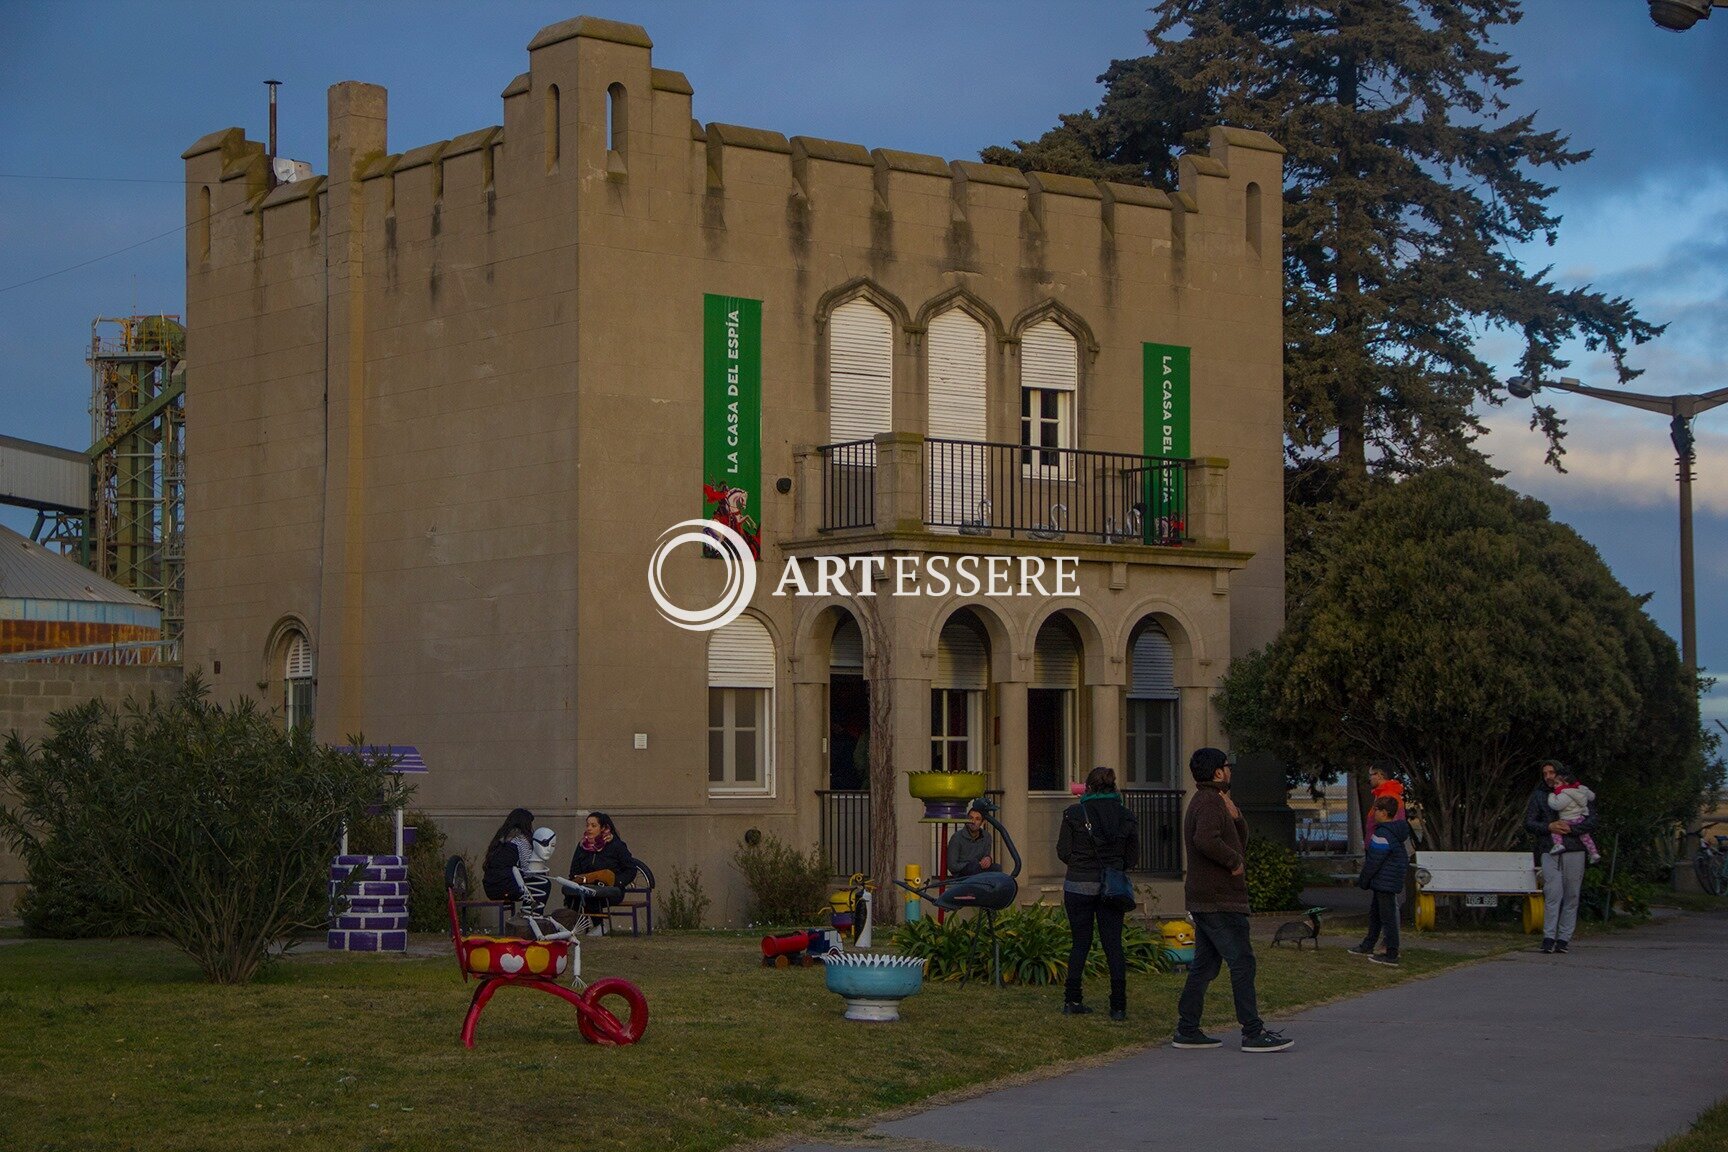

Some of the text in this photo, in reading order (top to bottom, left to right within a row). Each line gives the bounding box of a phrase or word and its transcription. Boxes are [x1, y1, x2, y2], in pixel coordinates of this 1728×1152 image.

[1163, 355, 1172, 375] LA
[725, 310, 738, 473] LA CASA DEL ESPÍA
[1163, 380, 1172, 420] CASA
[1163, 425, 1172, 454] DEL
